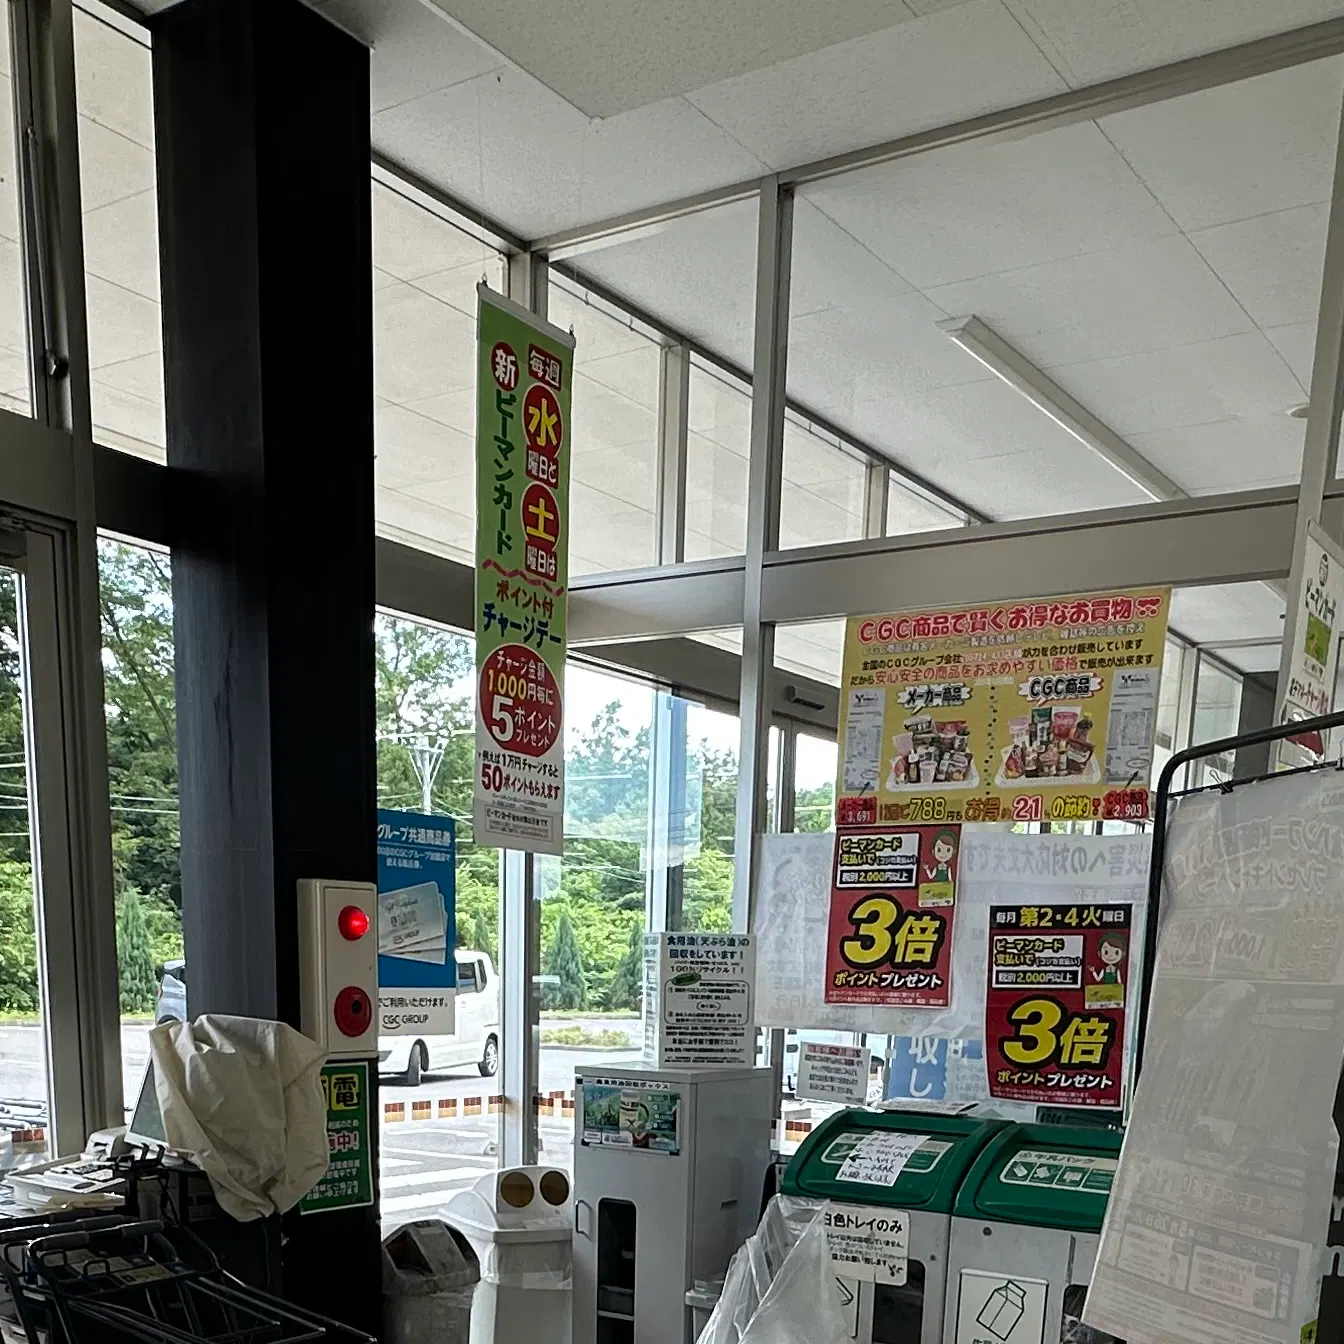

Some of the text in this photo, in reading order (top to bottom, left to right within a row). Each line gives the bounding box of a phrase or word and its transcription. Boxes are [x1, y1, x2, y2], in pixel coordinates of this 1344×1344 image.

[529, 349, 561, 388] 毎週
[528, 398, 558, 447] 水
[527, 449, 557, 484] 曜日と
[526, 498, 556, 543] 土
[526, 545, 556, 576] 曜日は
[482, 602, 562, 649] チャージデー
[1029, 677, 1092, 698] CGC商品
[490, 694, 514, 742] 5
[843, 897, 941, 965] 3倍
[995, 937, 1063, 952] ピーマンカード
[402, 1013, 430, 1025] GROUP
[1003, 998, 1111, 1065] 3倍
[1034, 1151, 1097, 1166] 牛乳パック
